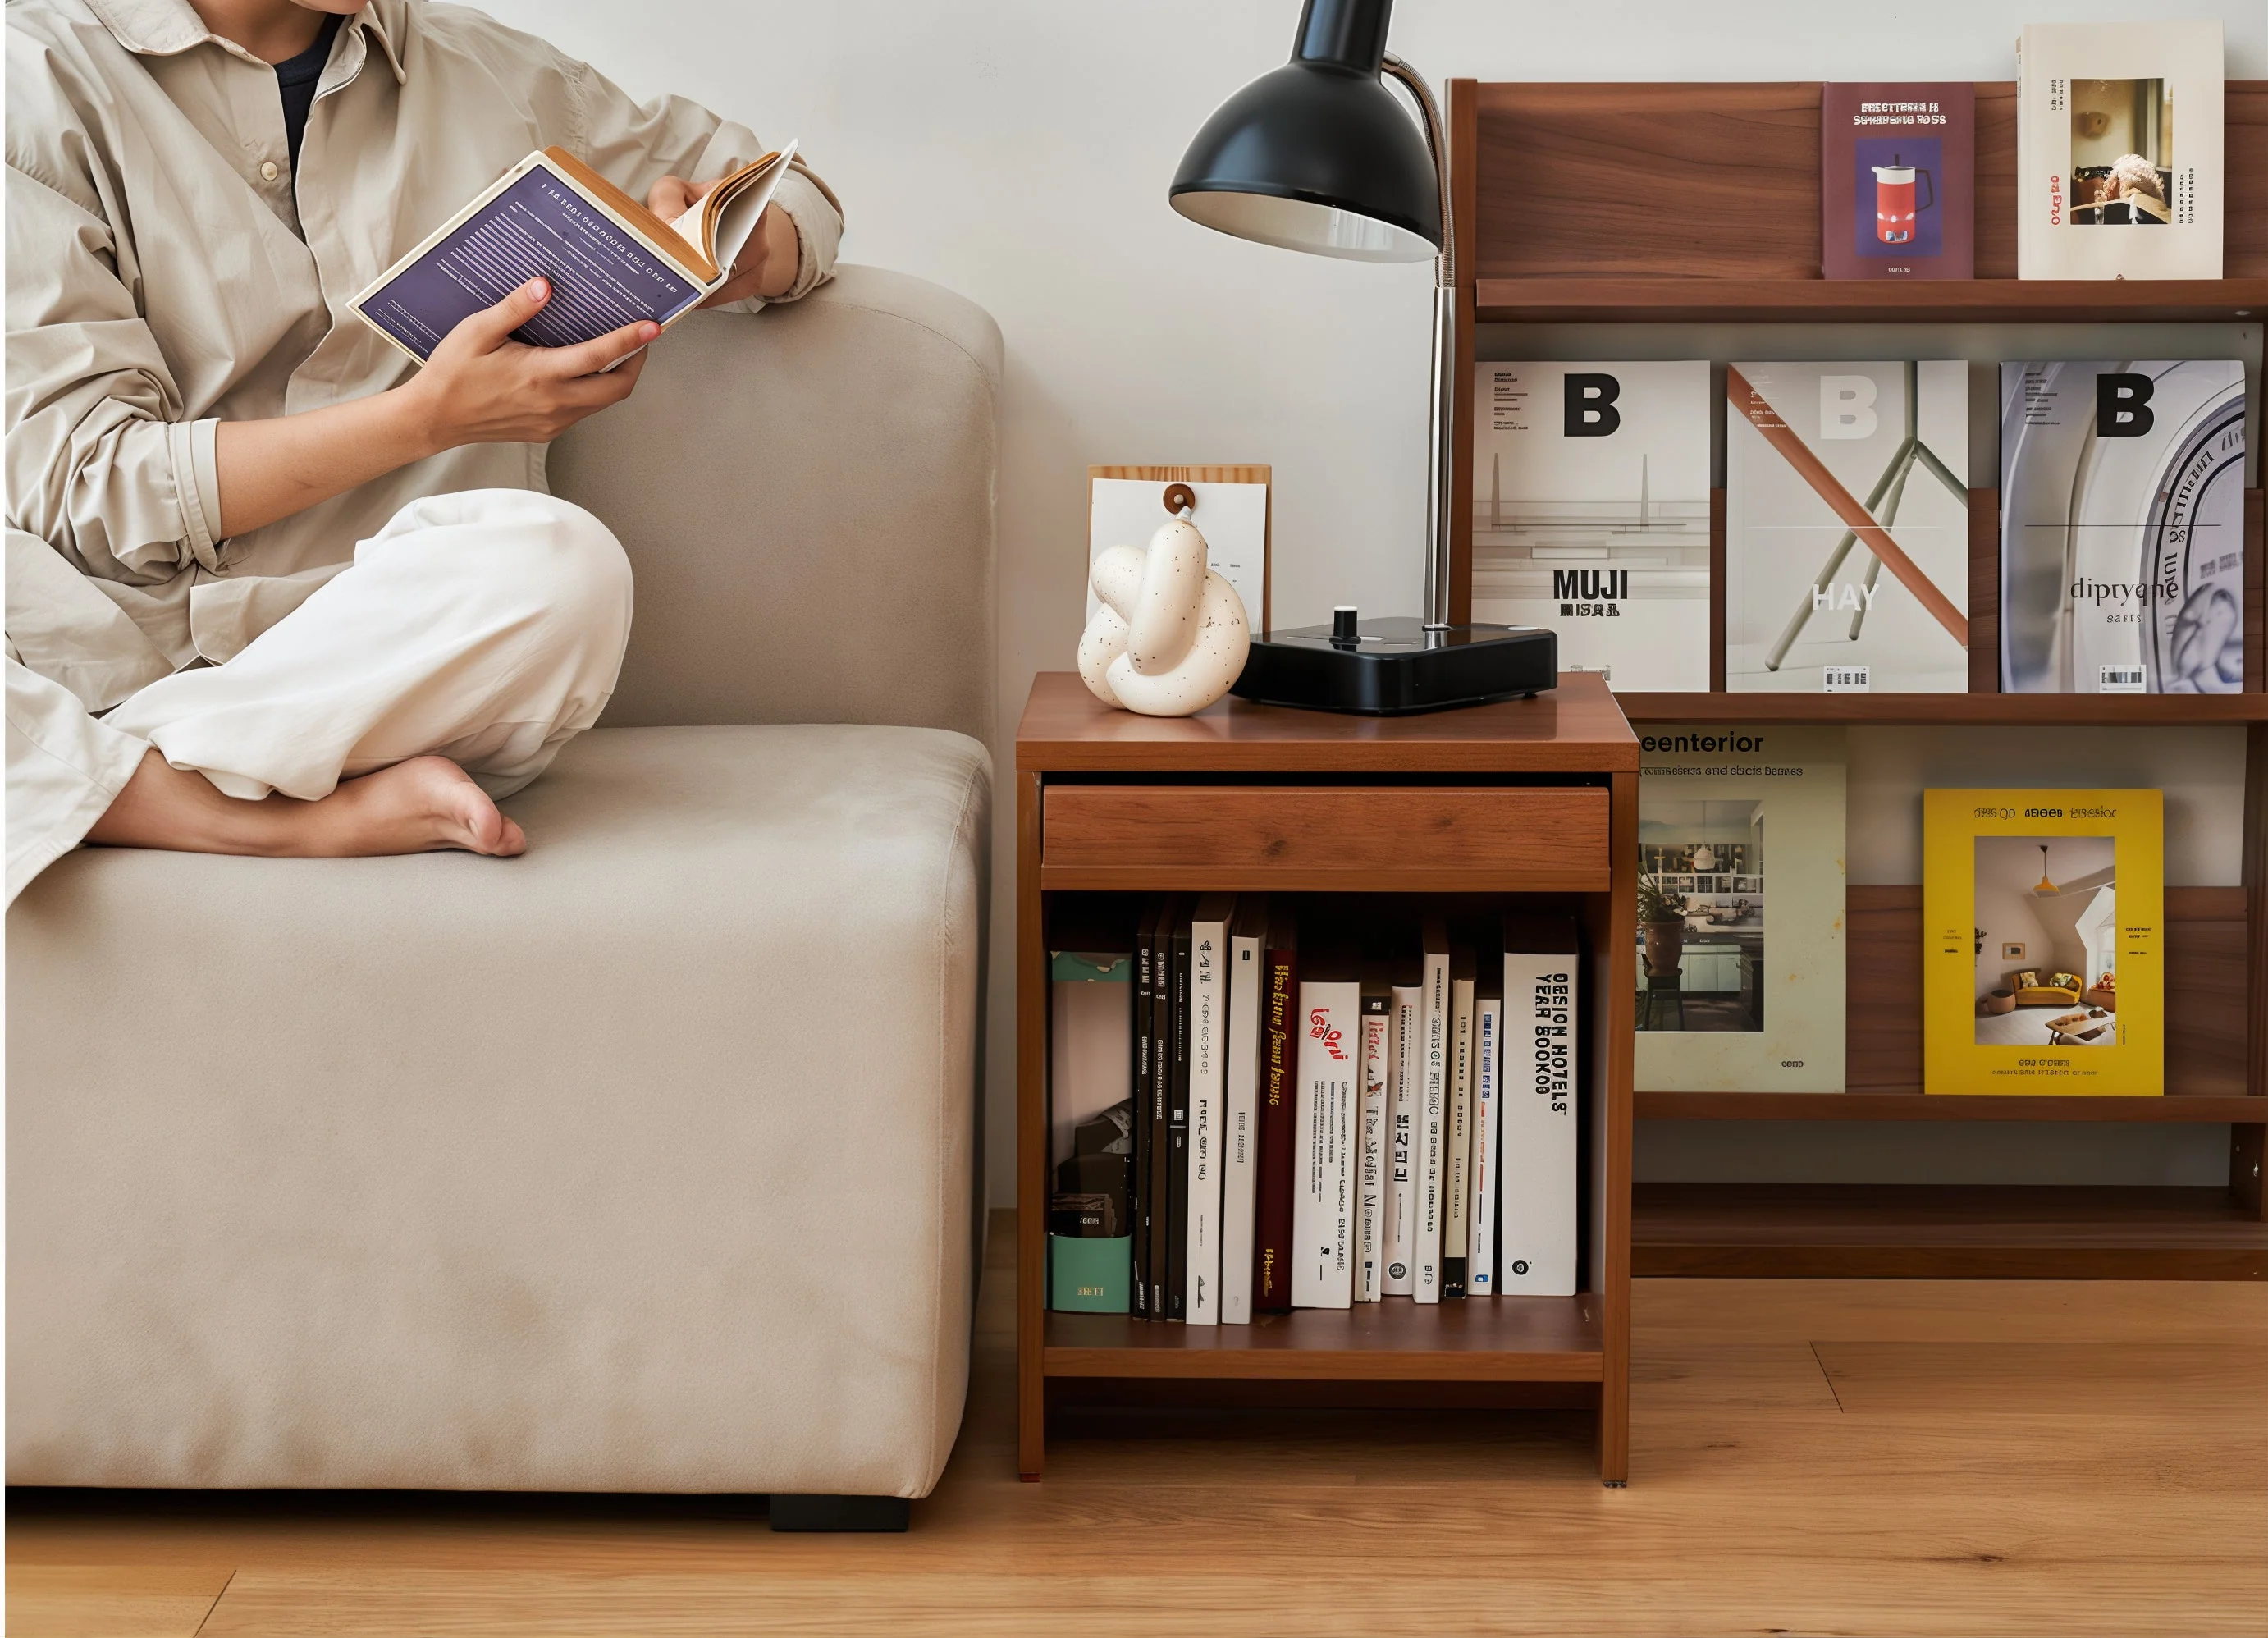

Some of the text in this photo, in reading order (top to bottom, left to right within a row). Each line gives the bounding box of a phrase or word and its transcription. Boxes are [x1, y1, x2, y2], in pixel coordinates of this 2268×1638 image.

[1564, 373, 1621, 437] B
[1820, 375, 1878, 439] B
[2097, 373, 2155, 437] B
[1553, 570, 1628, 600] MUJI
[1812, 583, 1880, 611] HAY
